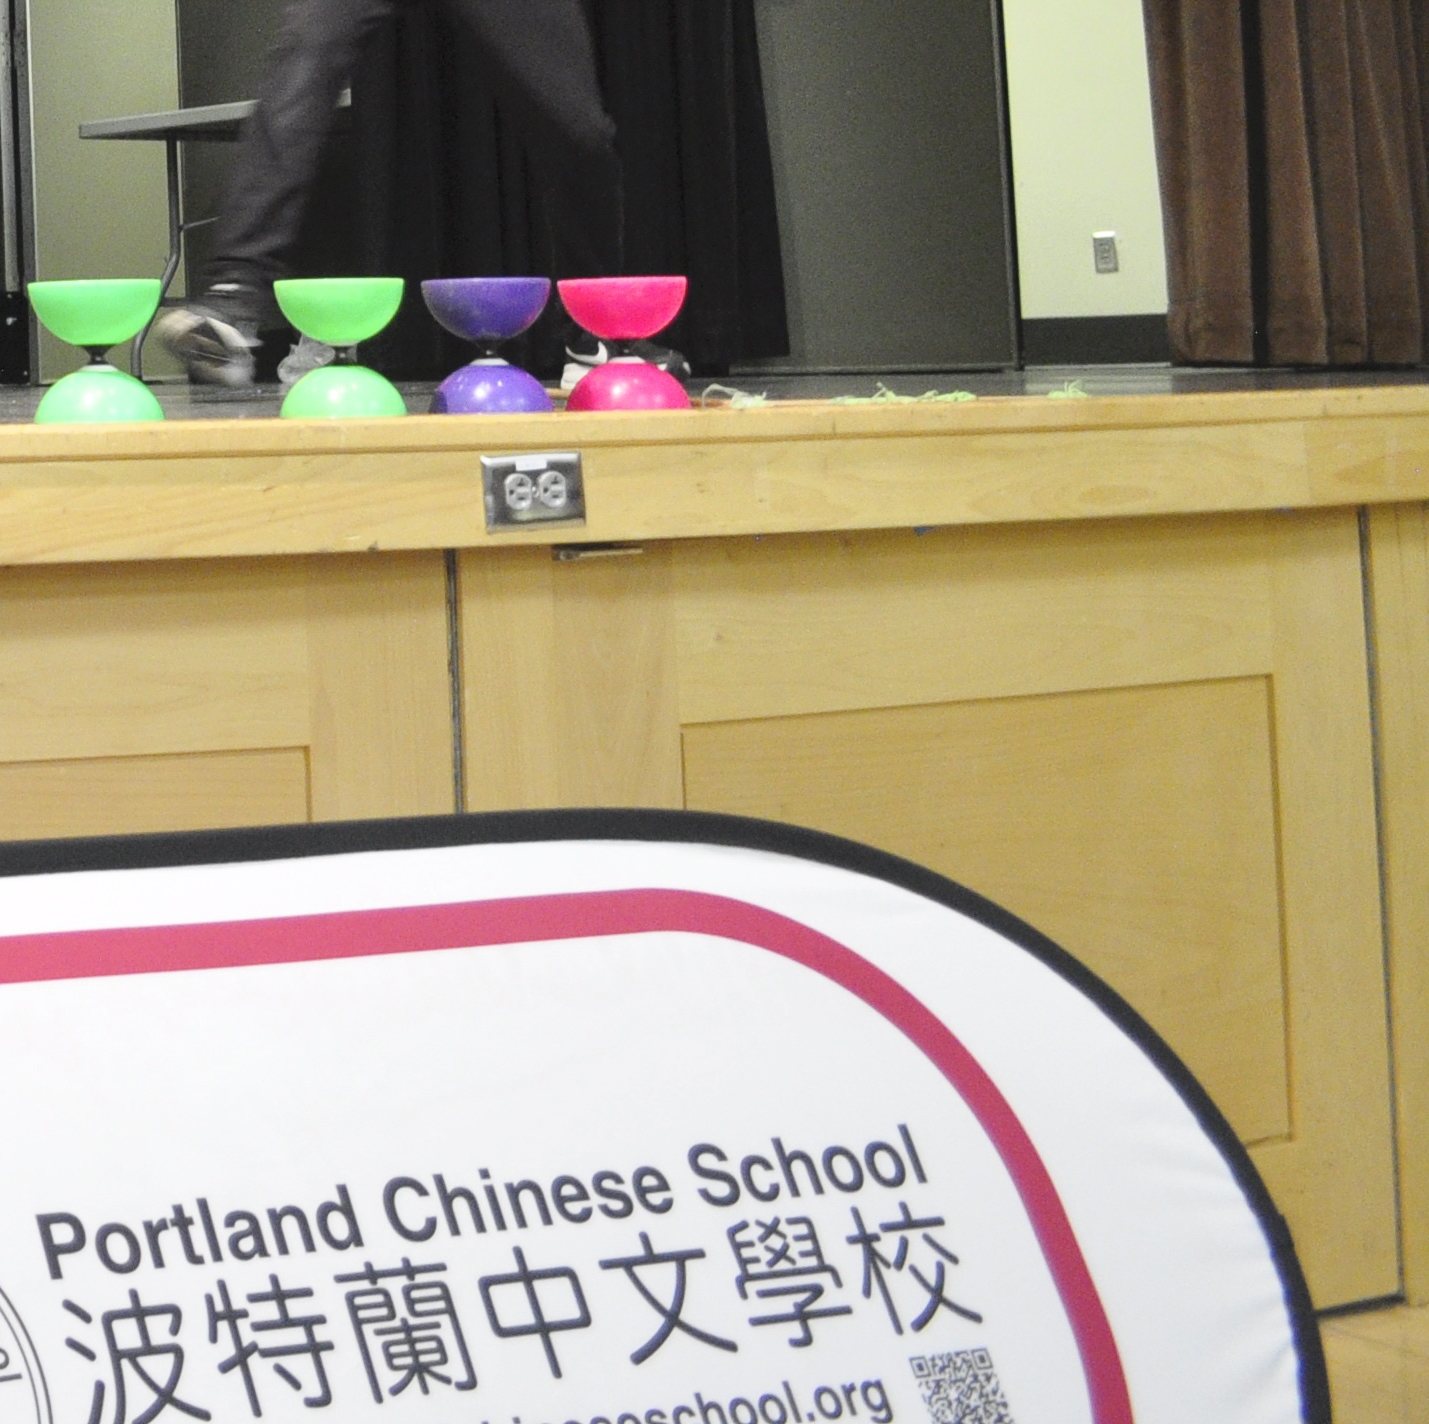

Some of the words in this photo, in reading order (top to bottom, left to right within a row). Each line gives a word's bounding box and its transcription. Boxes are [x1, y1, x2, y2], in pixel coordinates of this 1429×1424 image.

[35, 1183, 365, 1280] Portland
[381, 1166, 674, 1243] Chinese
[686, 1123, 929, 1208] School
[61, 1201, 983, 1424] 波特蘭中文學校
